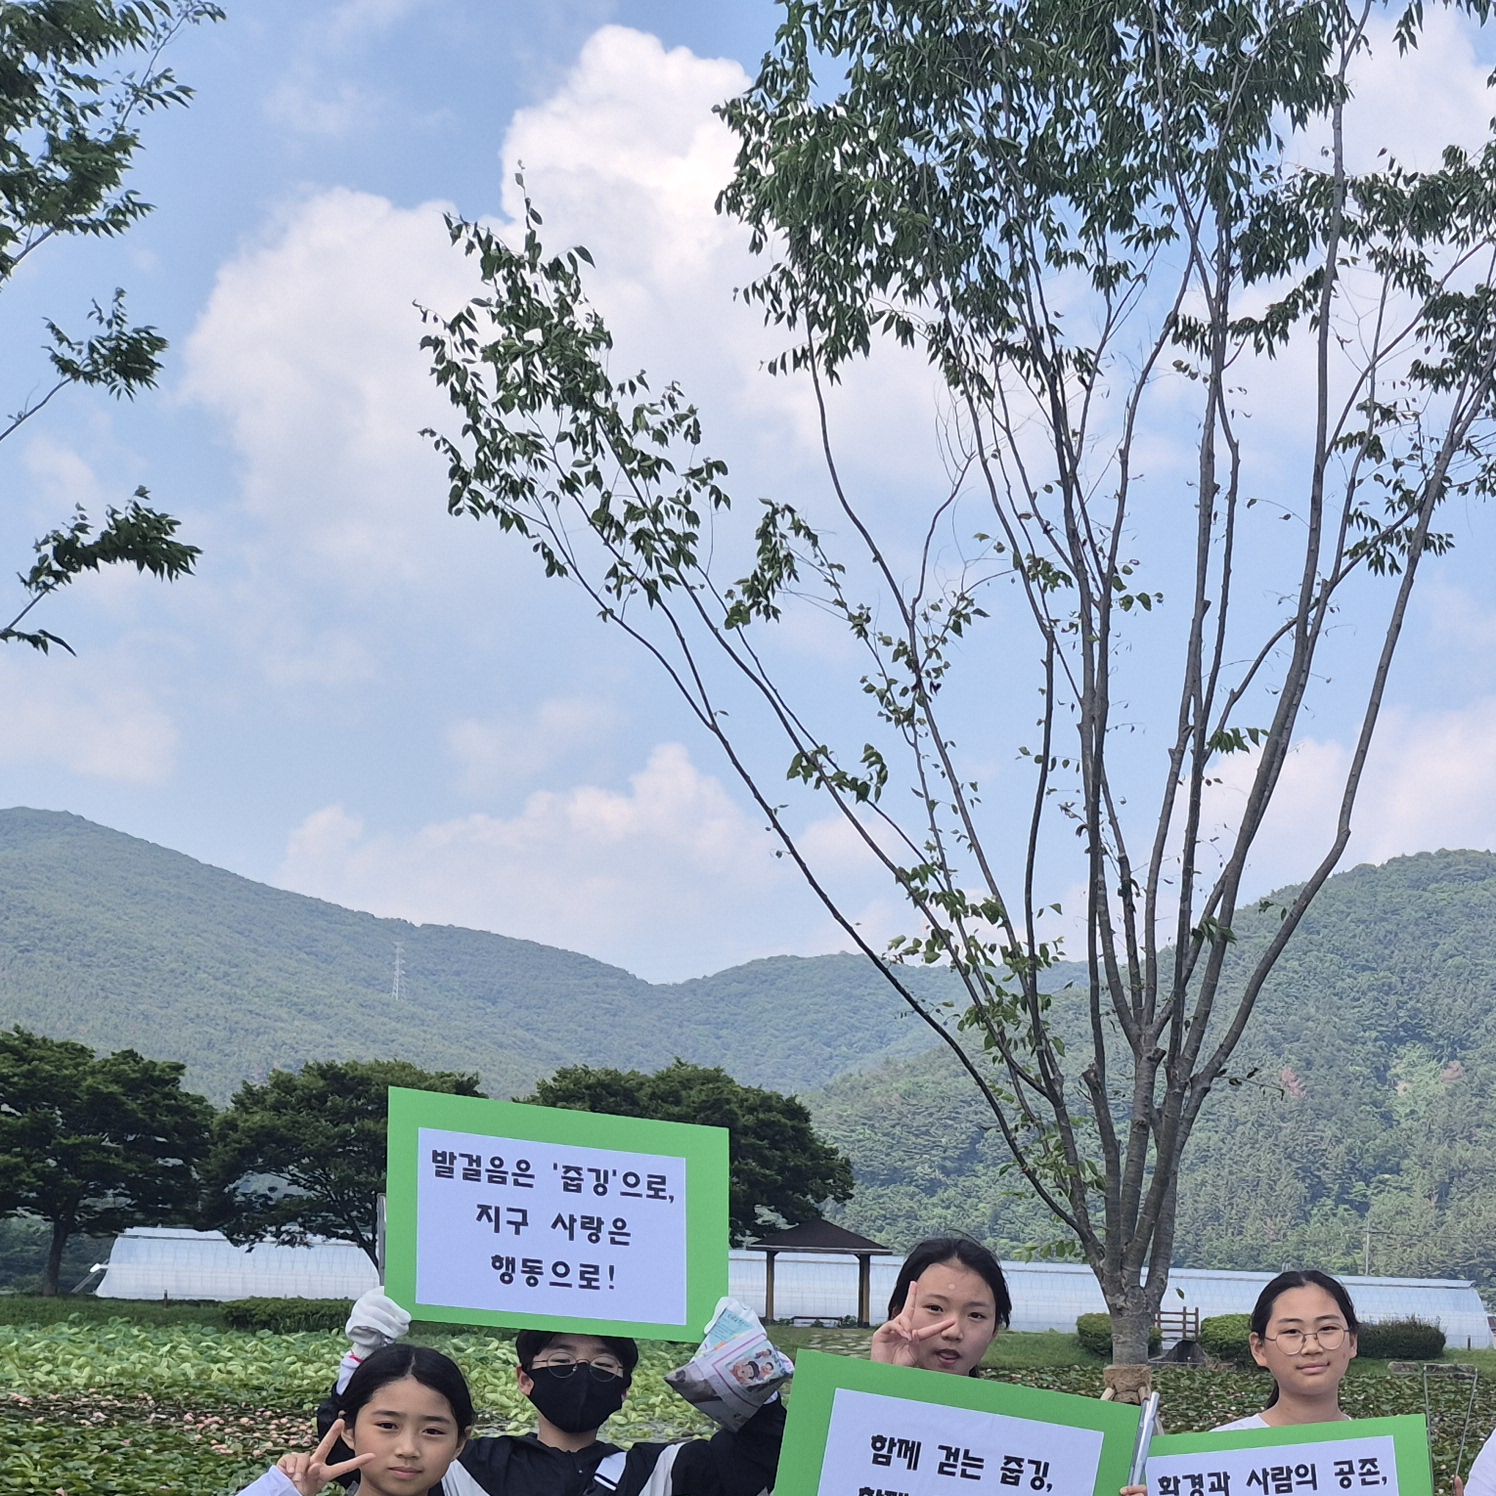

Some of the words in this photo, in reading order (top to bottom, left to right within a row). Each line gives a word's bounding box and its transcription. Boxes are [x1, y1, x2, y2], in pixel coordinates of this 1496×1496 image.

[432, 1150, 535, 1188] 발걸음은
[553, 1163, 674, 1203] '줍깅'으로,
[476, 1204, 528, 1235] 지구
[551, 1213, 631, 1246] 사랑은
[491, 1255, 614, 1290] 행동으로!
[871, 1435, 921, 1471] 함께
[938, 1445, 984, 1480] 걷는
[1000, 1455, 1052, 1492] 줍깅,
[1246, 1464, 1317, 1495] 사람의
[1334, 1458, 1387, 1489] 공존,
